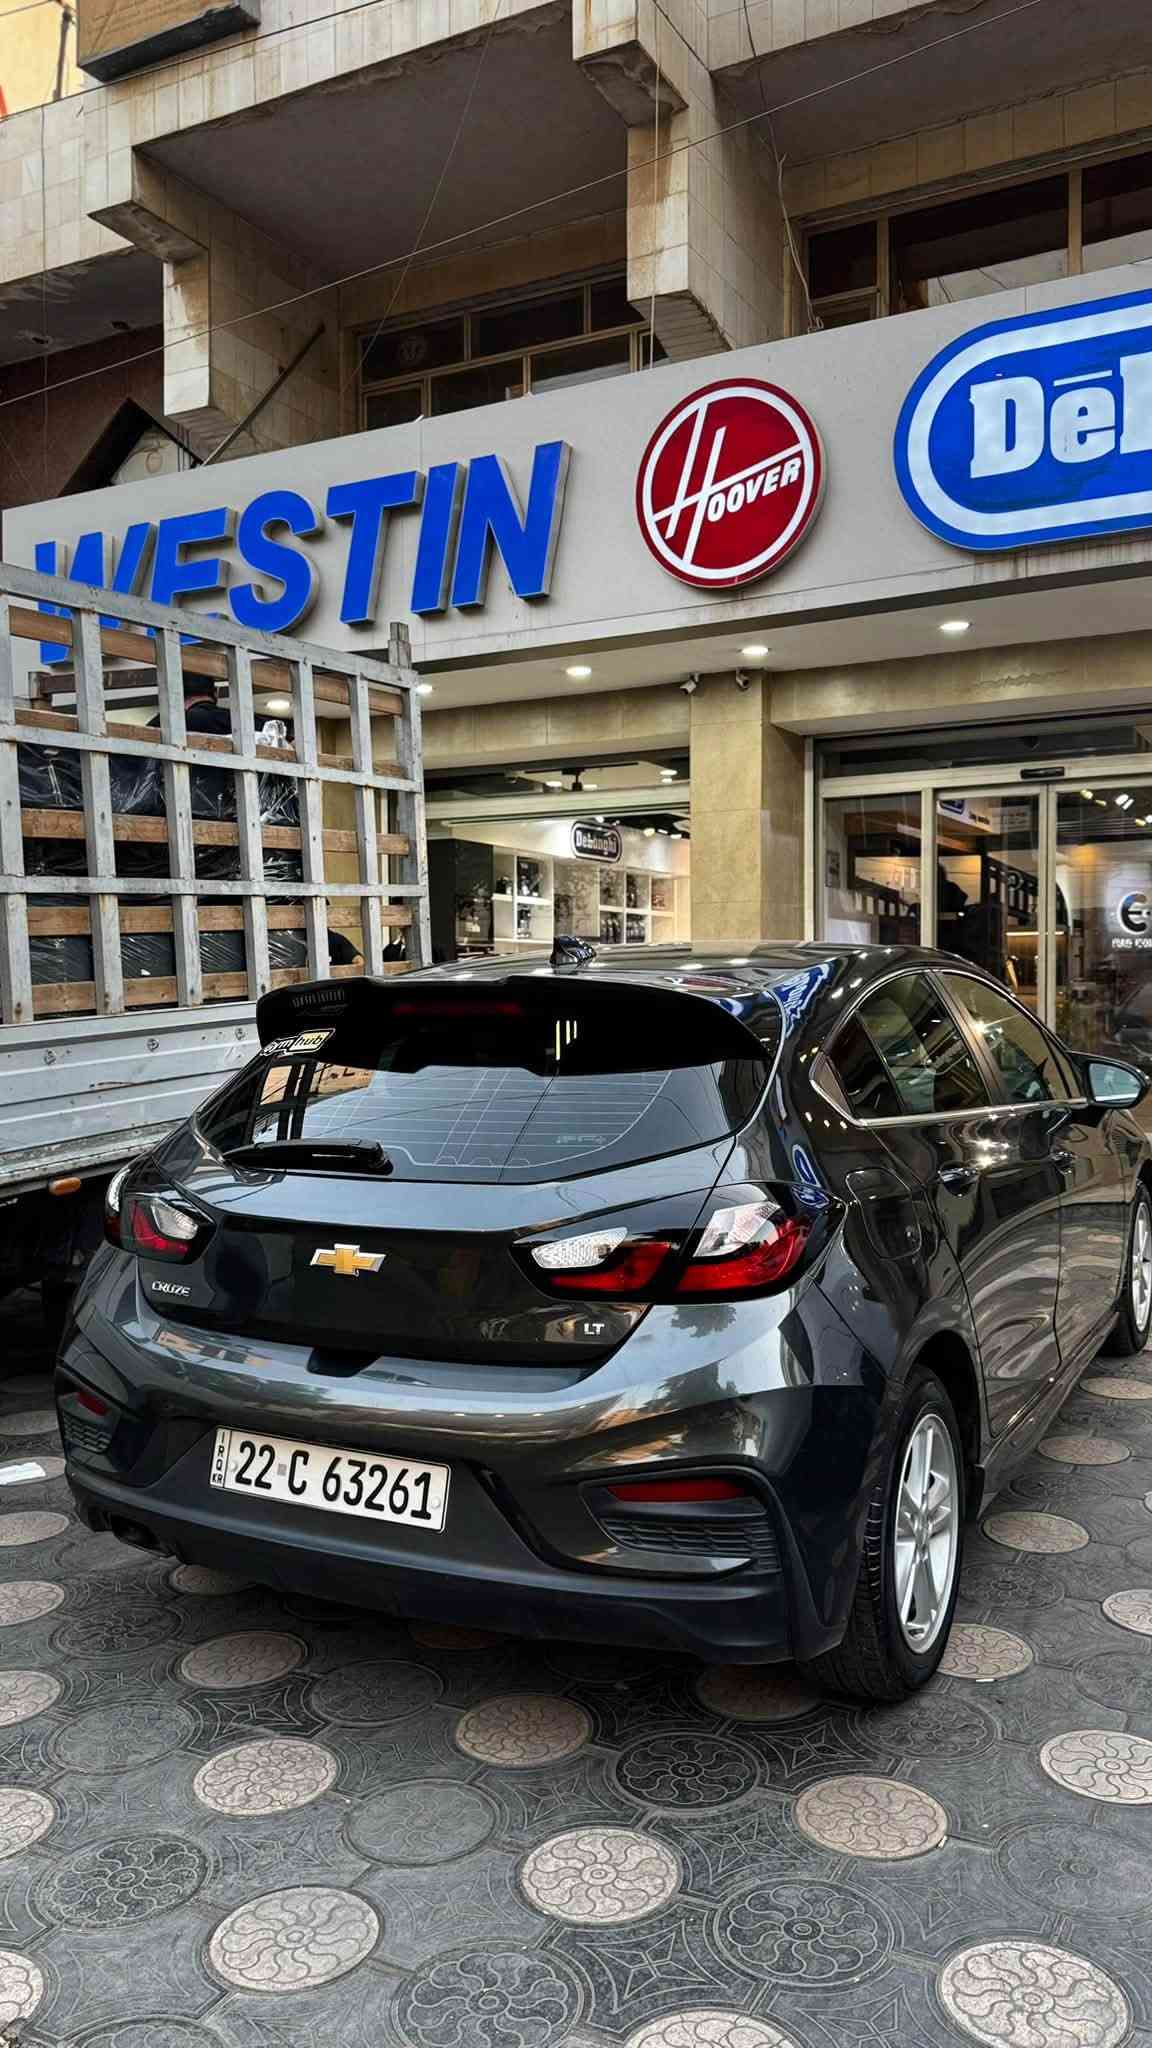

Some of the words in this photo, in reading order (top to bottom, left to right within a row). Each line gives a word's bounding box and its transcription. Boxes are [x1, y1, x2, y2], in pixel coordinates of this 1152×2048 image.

[34, 440, 570, 665] WESTIN
[152, 1281, 191, 1297] CRUZE
[584, 1323, 605, 1335] LT
[235, 1440, 276, 1490] 22
[287, 1449, 309, 1495] C
[322, 1456, 432, 1520] 63261
